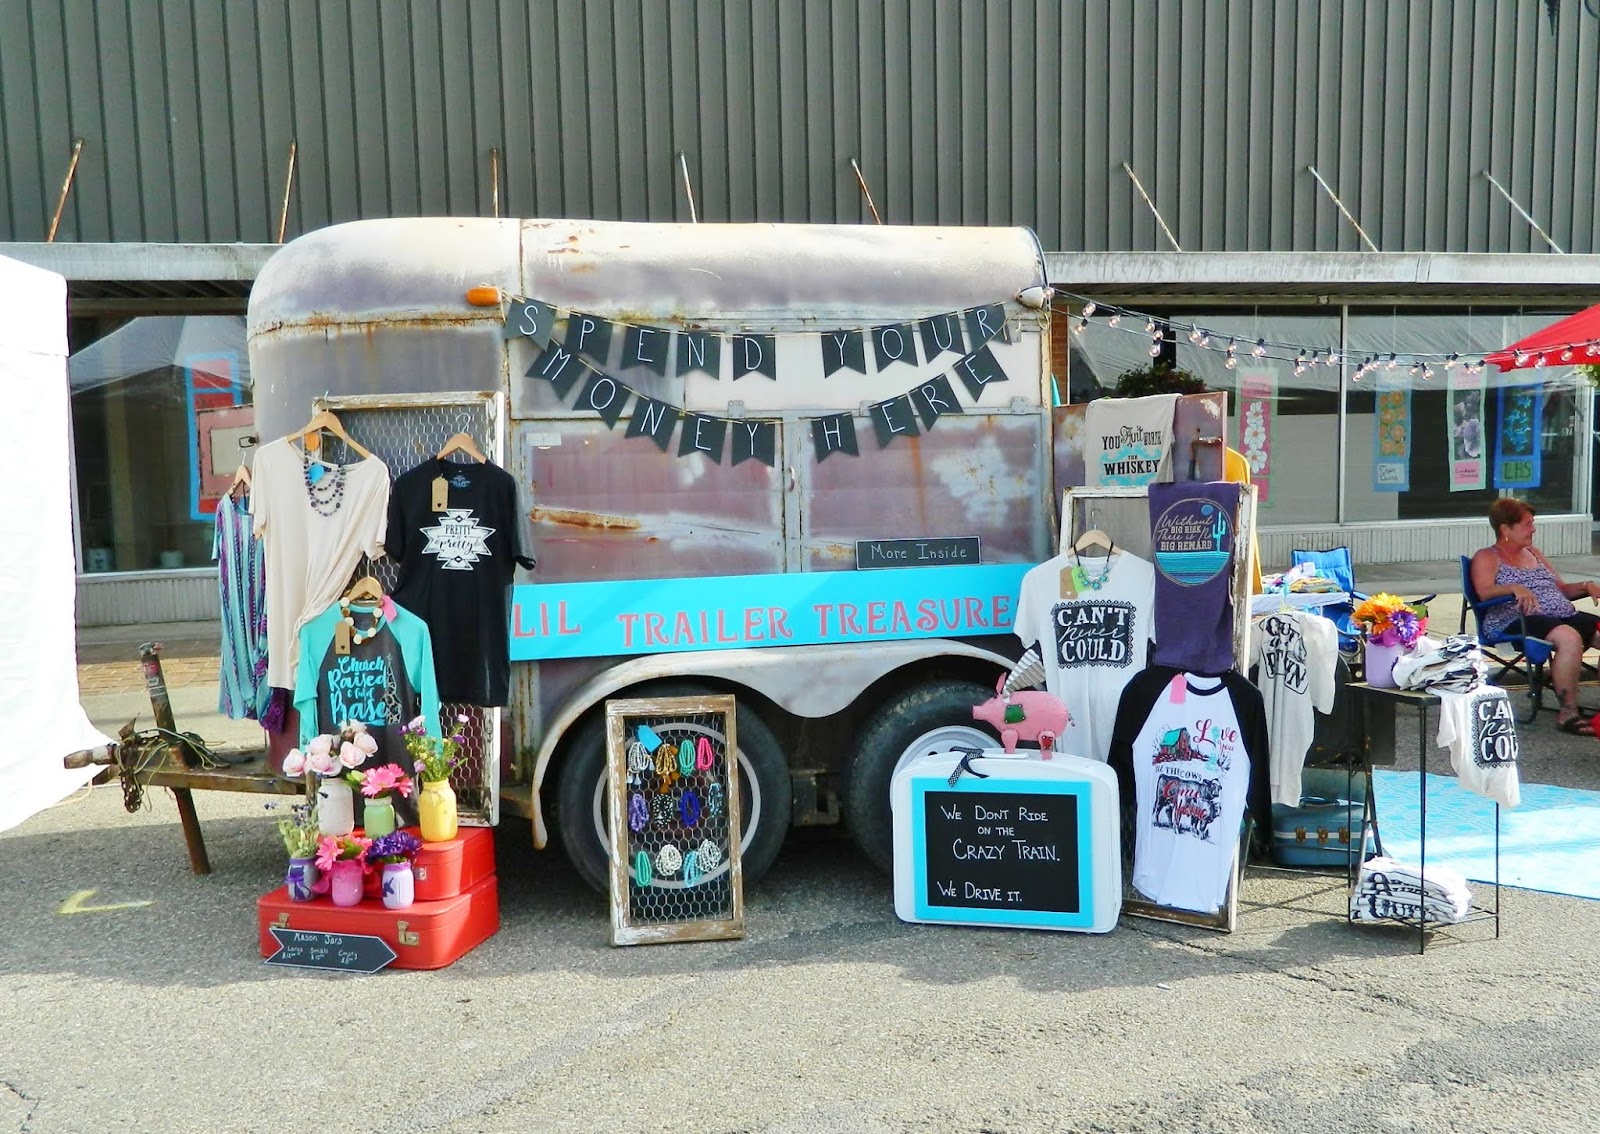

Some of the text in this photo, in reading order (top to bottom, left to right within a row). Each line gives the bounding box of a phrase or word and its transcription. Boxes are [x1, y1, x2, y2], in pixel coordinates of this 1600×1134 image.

[519, 305, 997, 371] SPEND YOUR
[542, 348, 992, 456] MONEY HERE
[1101, 435, 1121, 450] YOU
[1103, 459, 1161, 476] WHISKEY
[445, 524, 472, 535] PRETTY
[1161, 514, 1213, 528] Without
[1170, 525, 1202, 534] BIG RISK
[870, 543, 967, 560] More Inside
[1160, 541, 1175, 551] BIG
[513, 594, 1016, 648] LIL TRAILER TREASURE
[1057, 606, 1129, 627] CAN'T
[1061, 637, 1126, 662] COULD
[327, 665, 387, 692] Raised
[330, 690, 388, 724] Prase
[1192, 718, 1239, 748] Love
[977, 826, 1014, 836] ON THE
[293, 932, 343, 945] Mason Jars
